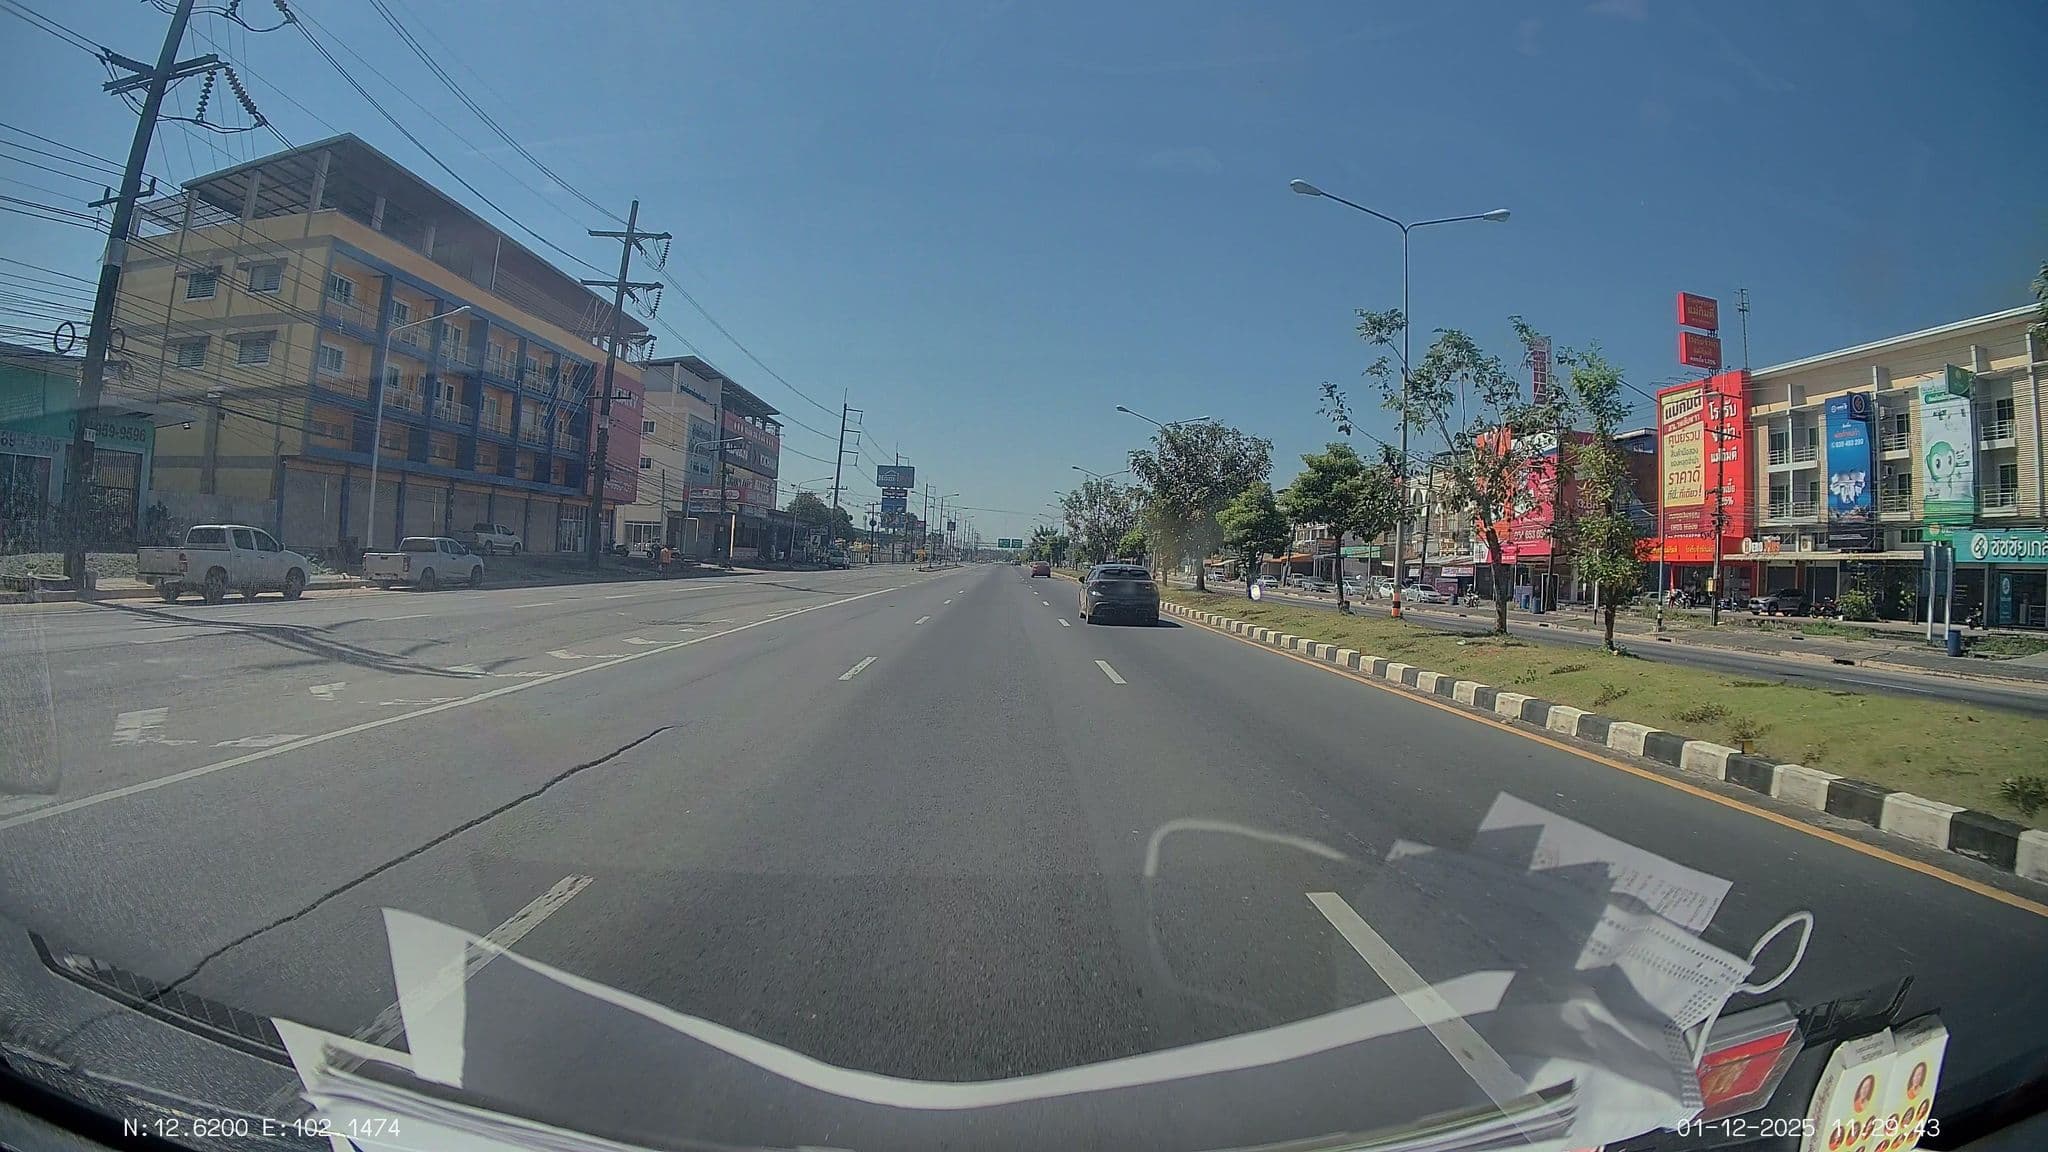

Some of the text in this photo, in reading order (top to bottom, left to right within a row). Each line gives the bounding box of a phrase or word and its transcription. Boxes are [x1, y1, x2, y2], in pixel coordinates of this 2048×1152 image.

[1709, 398, 1737, 420] โรรับ
[1668, 465, 1701, 485] ราคาดี
